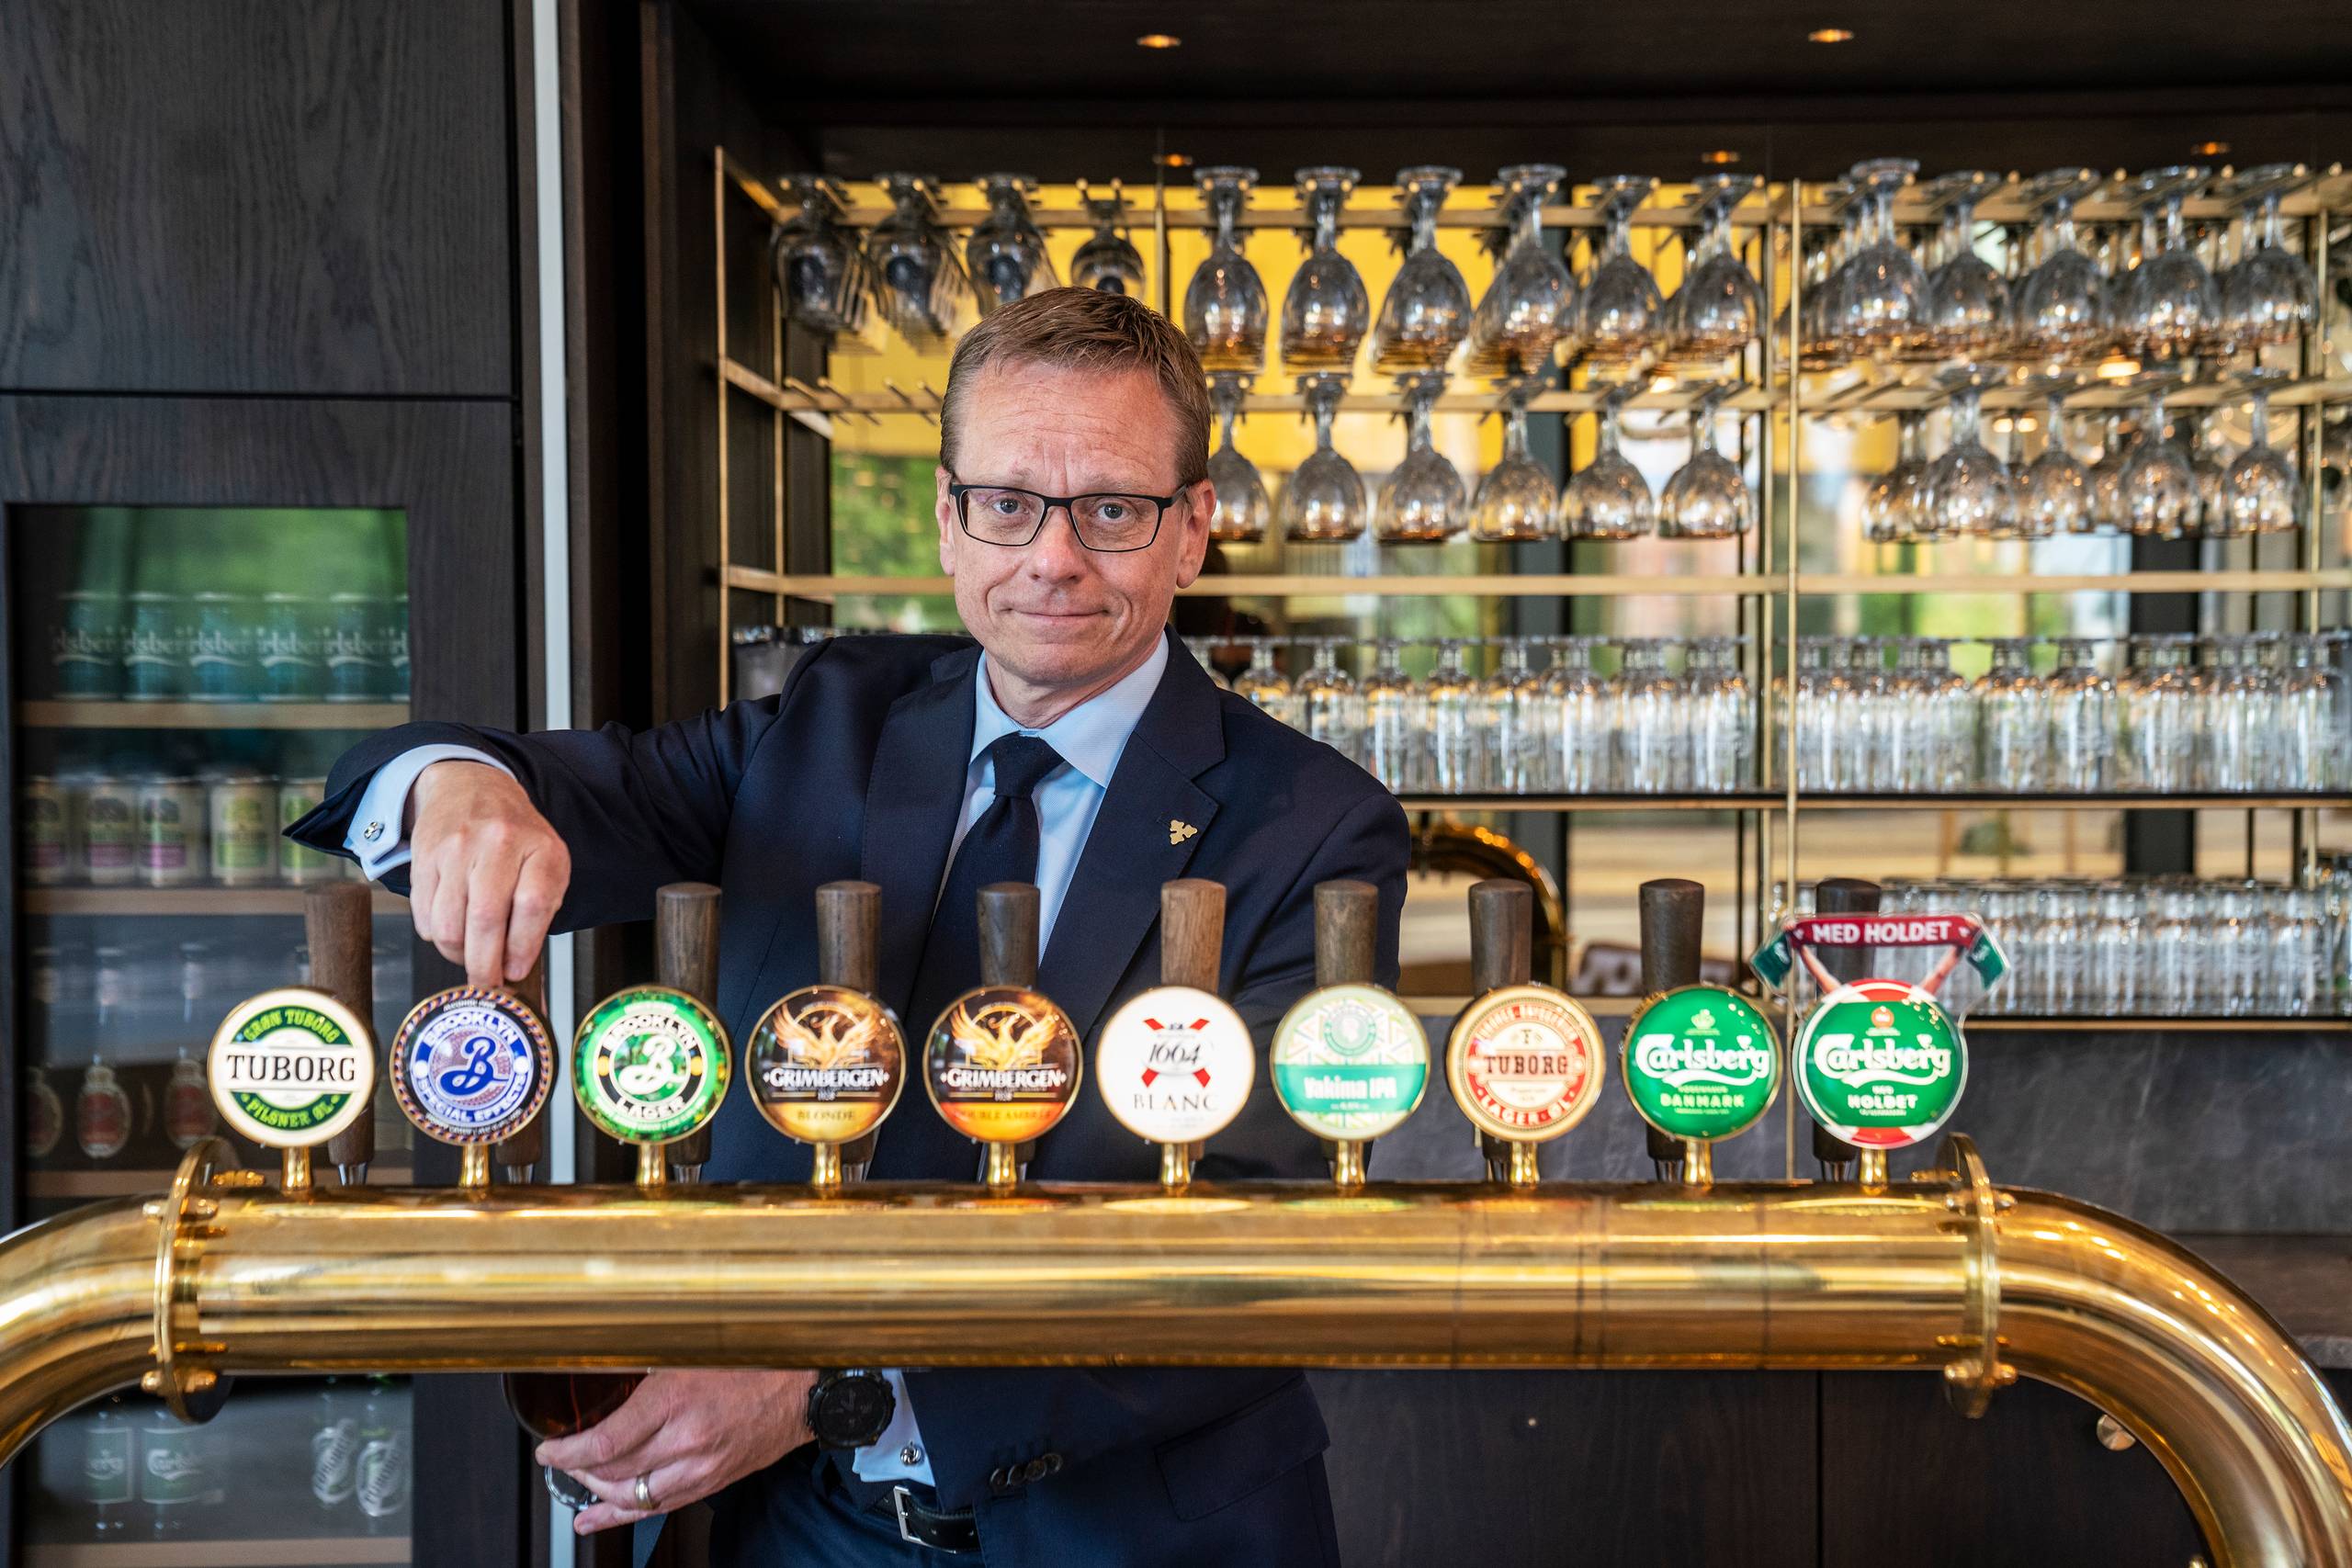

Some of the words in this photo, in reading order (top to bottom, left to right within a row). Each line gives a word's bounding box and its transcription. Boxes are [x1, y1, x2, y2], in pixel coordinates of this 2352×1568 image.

[1812, 923, 1860, 943] MED
[1864, 921, 1952, 942] HOLDET
[285, 1009, 341, 1043] TUBORG
[424, 1012, 519, 1046] BROOKLYN
[602, 1015, 697, 1051] BROOKLYN
[1148, 1042, 1202, 1065] 1664
[1485, 1055, 1569, 1075] TUBORG
[1635, 1033, 1770, 1088] Carlsberg
[1814, 1033, 1951, 1089] Carlsberg
[227, 1055, 355, 1082] TUBORG
[769, 1067, 885, 1088] GRIMBERGEN
[946, 1067, 1062, 1088] GRIMBERGEN
[416, 1077, 472, 1122] SPECIAL
[616, 1096, 686, 1120] LAGER
[1134, 1093, 1221, 1111] BLANC
[1480, 1095, 1539, 1126] LAGER
[1660, 1093, 1745, 1108] DANMARK
[1848, 1094, 1918, 1109] HOLDET
[246, 1099, 311, 1128] PILSNER
